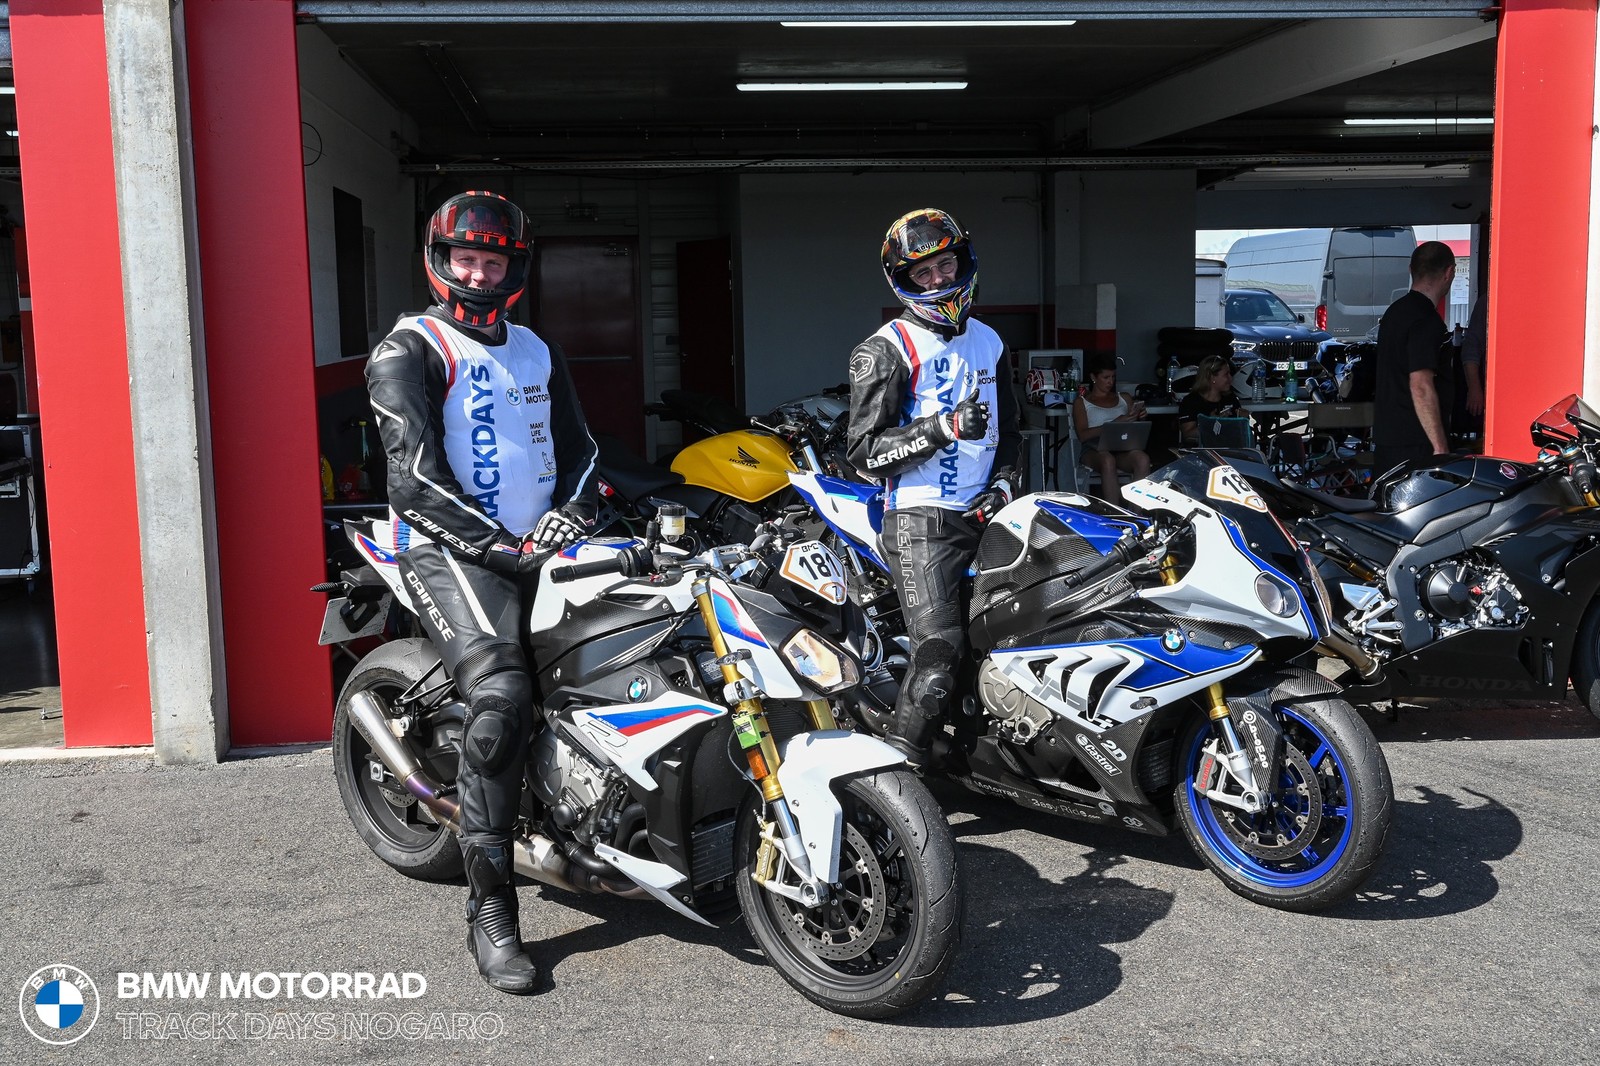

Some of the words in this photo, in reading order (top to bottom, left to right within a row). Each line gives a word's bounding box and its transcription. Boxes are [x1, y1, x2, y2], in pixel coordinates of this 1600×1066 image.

[523, 385, 542, 395] BMW
[530, 422, 544, 430] MAKE
[537, 436, 547, 444] RIDE
[934, 357, 959, 497] TRACAYS
[471, 364, 500, 519] ACKDAYS
[866, 436, 929, 470] BERING
[728, 457, 759, 469] HONDA
[1222, 474, 1253, 495] 18
[403, 509, 483, 557] DAINESE
[799, 552, 841, 581] 181
[897, 514, 920, 608] BERING
[405, 570, 456, 642] DAINESE
[1416, 674, 1534, 693] HONDA
[1084, 744, 1118, 774] Castrol
[1100, 739, 1127, 762] 2D
